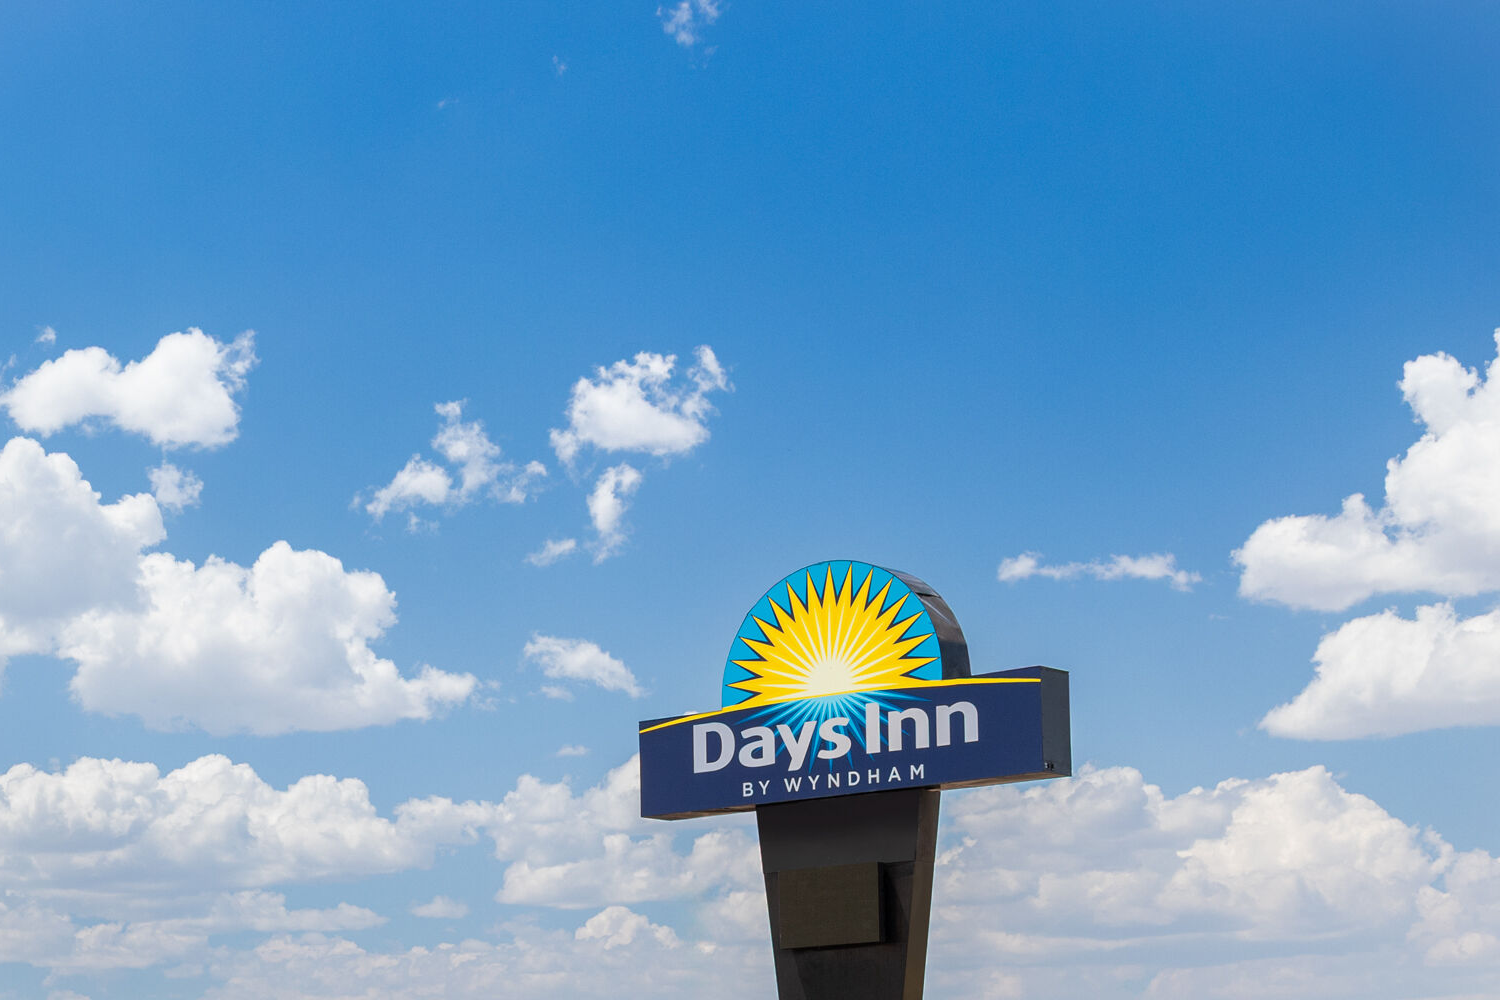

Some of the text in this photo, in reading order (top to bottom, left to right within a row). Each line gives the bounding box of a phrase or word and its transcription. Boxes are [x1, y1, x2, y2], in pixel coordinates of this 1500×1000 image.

[693, 701, 979, 774] Days Inn
[742, 764, 925, 797] BY WYNDHAM
